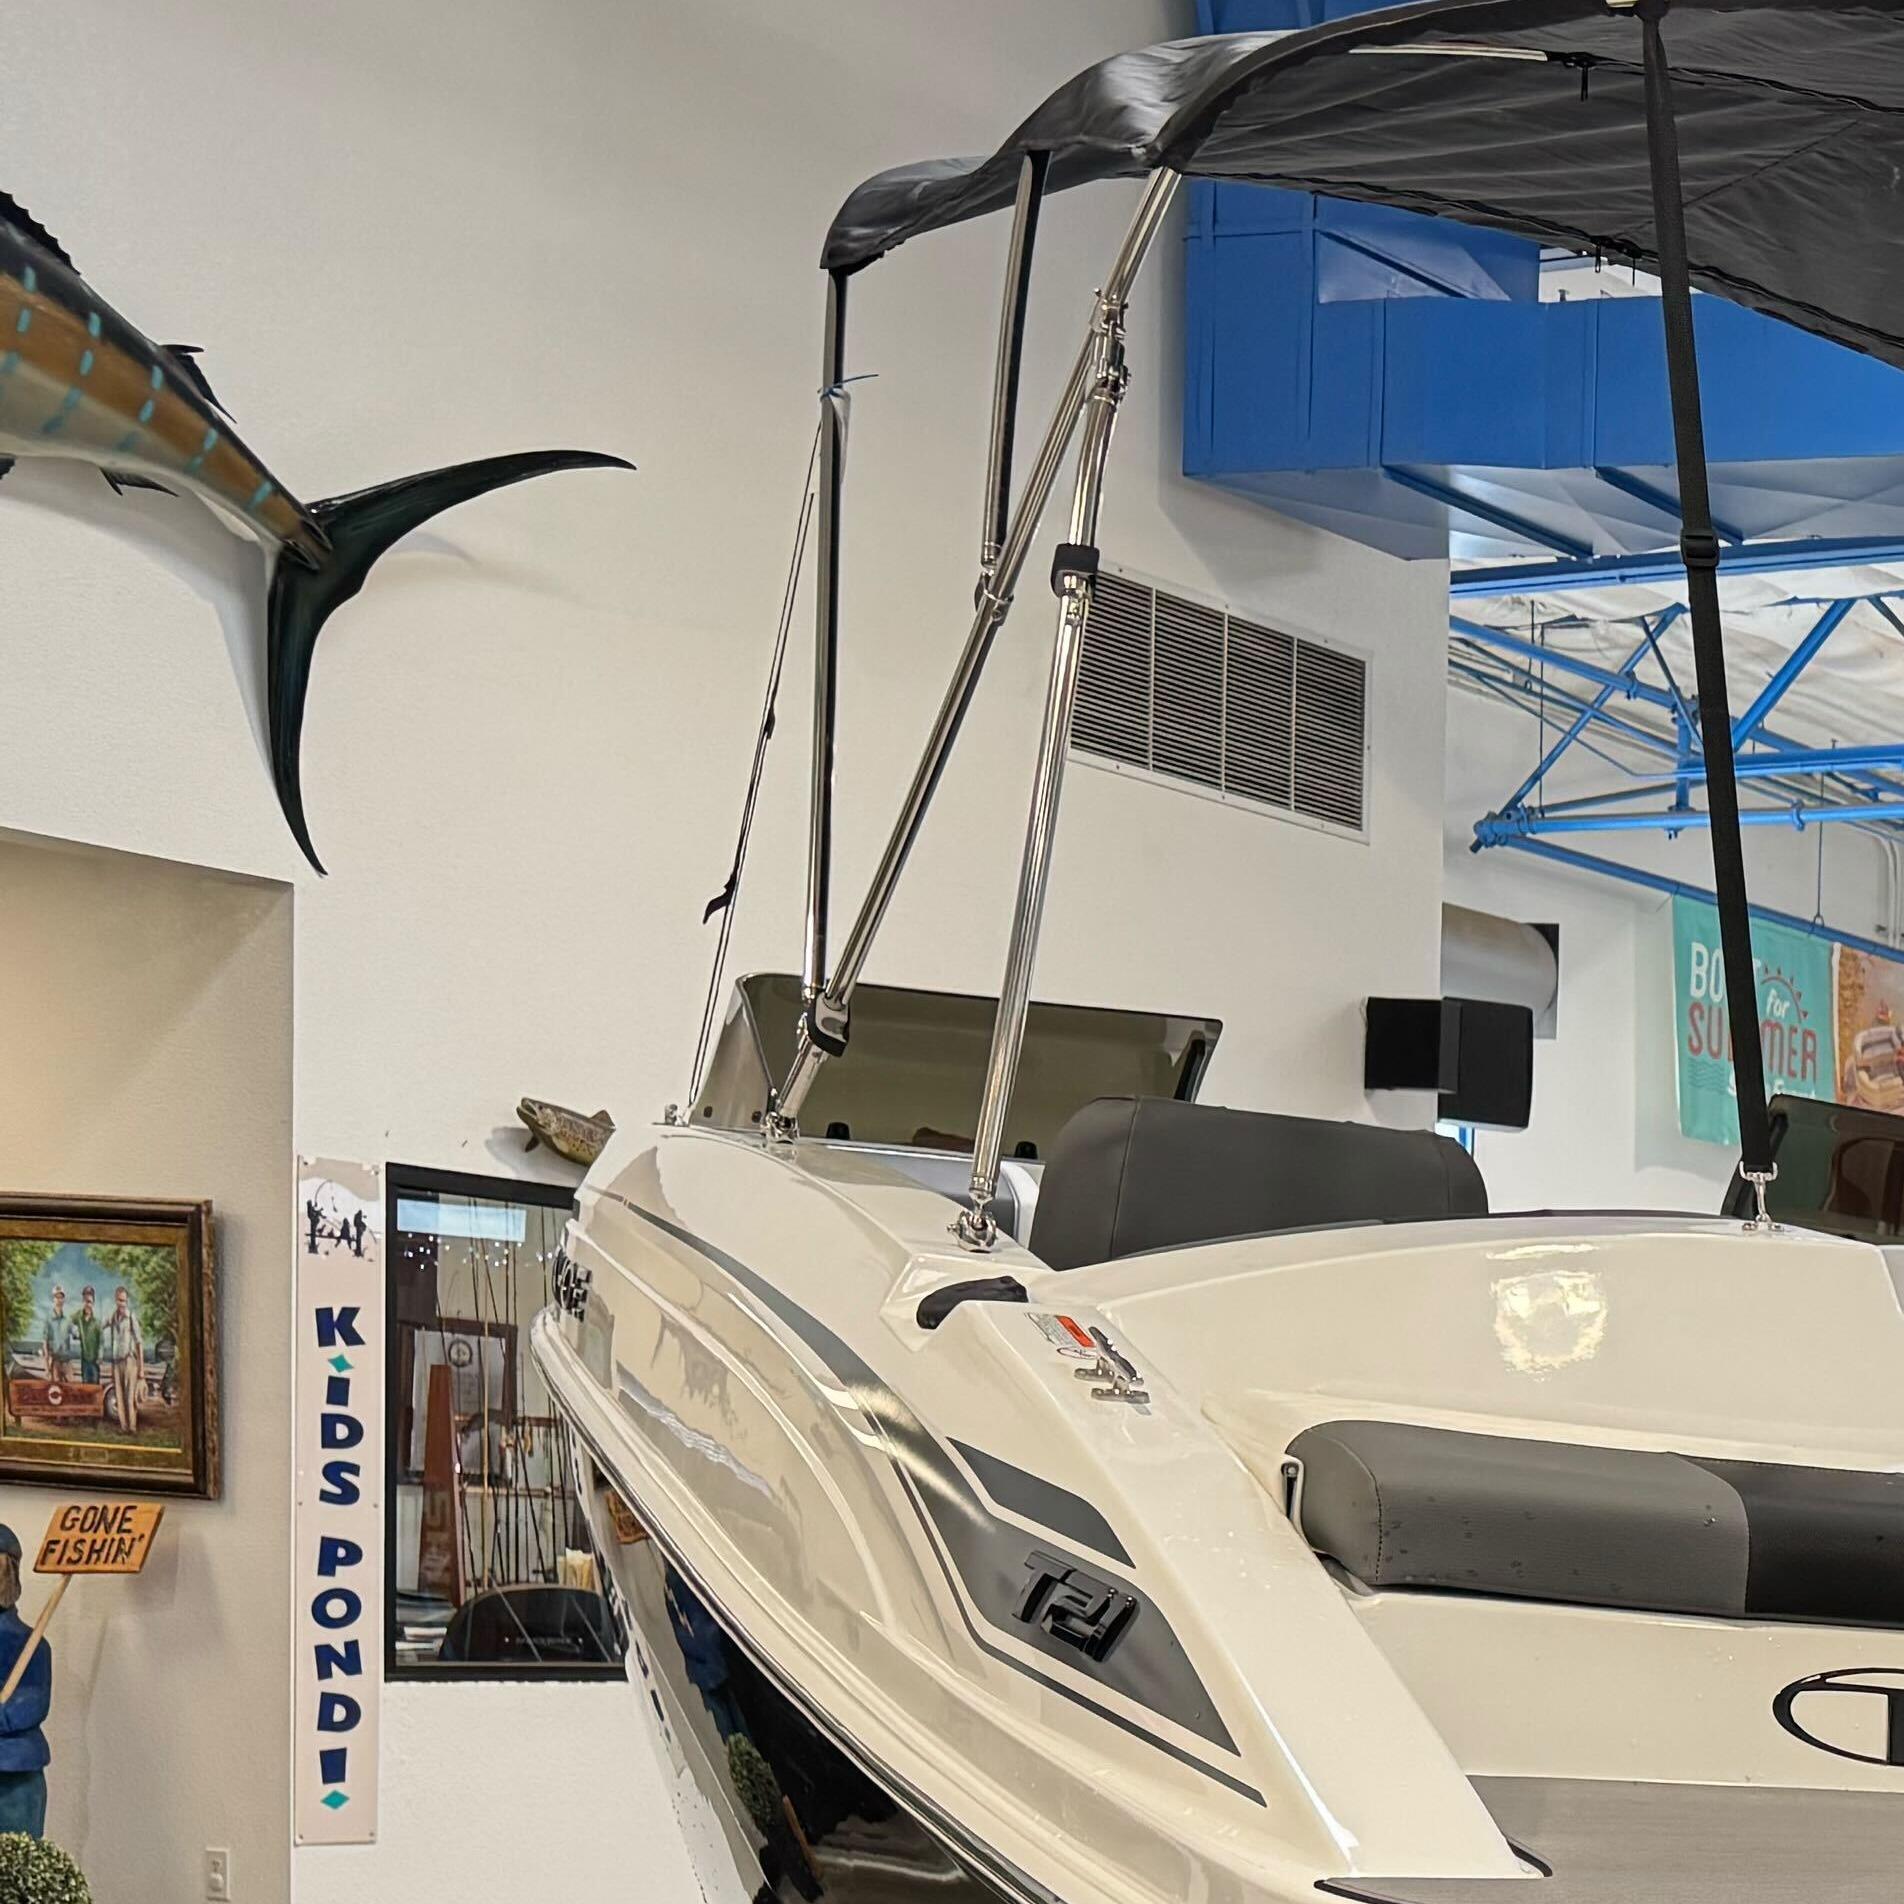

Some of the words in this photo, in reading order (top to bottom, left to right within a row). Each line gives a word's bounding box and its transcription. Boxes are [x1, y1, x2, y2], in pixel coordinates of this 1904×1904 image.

[1690, 941, 1761, 1002] BOT
[1688, 1001, 1817, 1082] SUMER
[59, 1504, 138, 1534] GONE
[39, 1534, 145, 1566] FISHIN'
